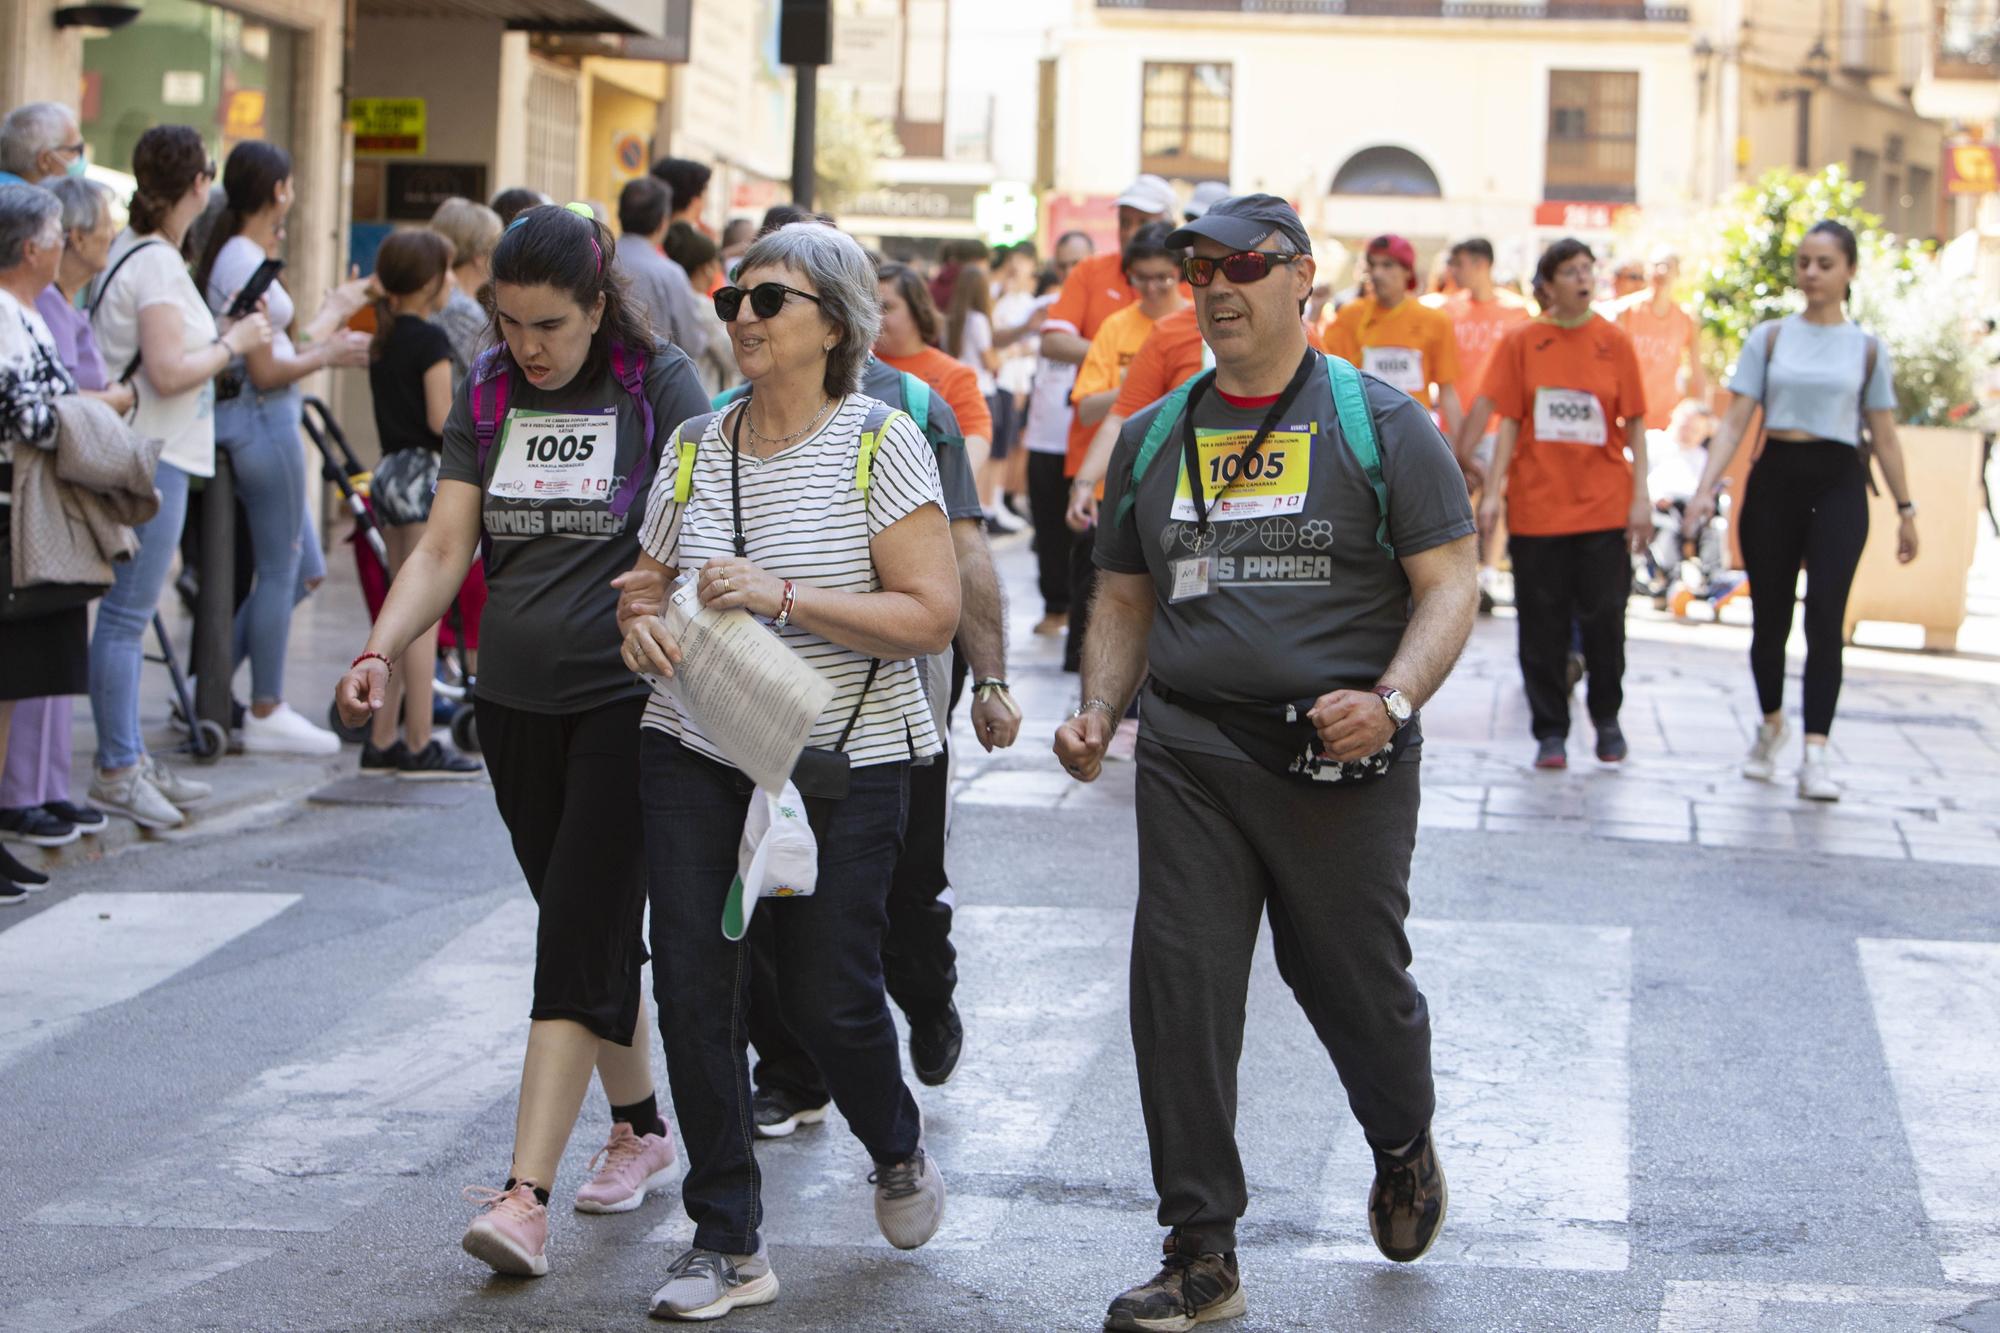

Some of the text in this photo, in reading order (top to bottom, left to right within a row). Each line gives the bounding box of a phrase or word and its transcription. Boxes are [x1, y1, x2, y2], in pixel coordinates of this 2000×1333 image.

[1549, 403, 1590, 420] 1005
[526, 435, 597, 462] 1005
[1210, 451, 1285, 482] 1005
[1243, 555, 1332, 579] PRAGA
